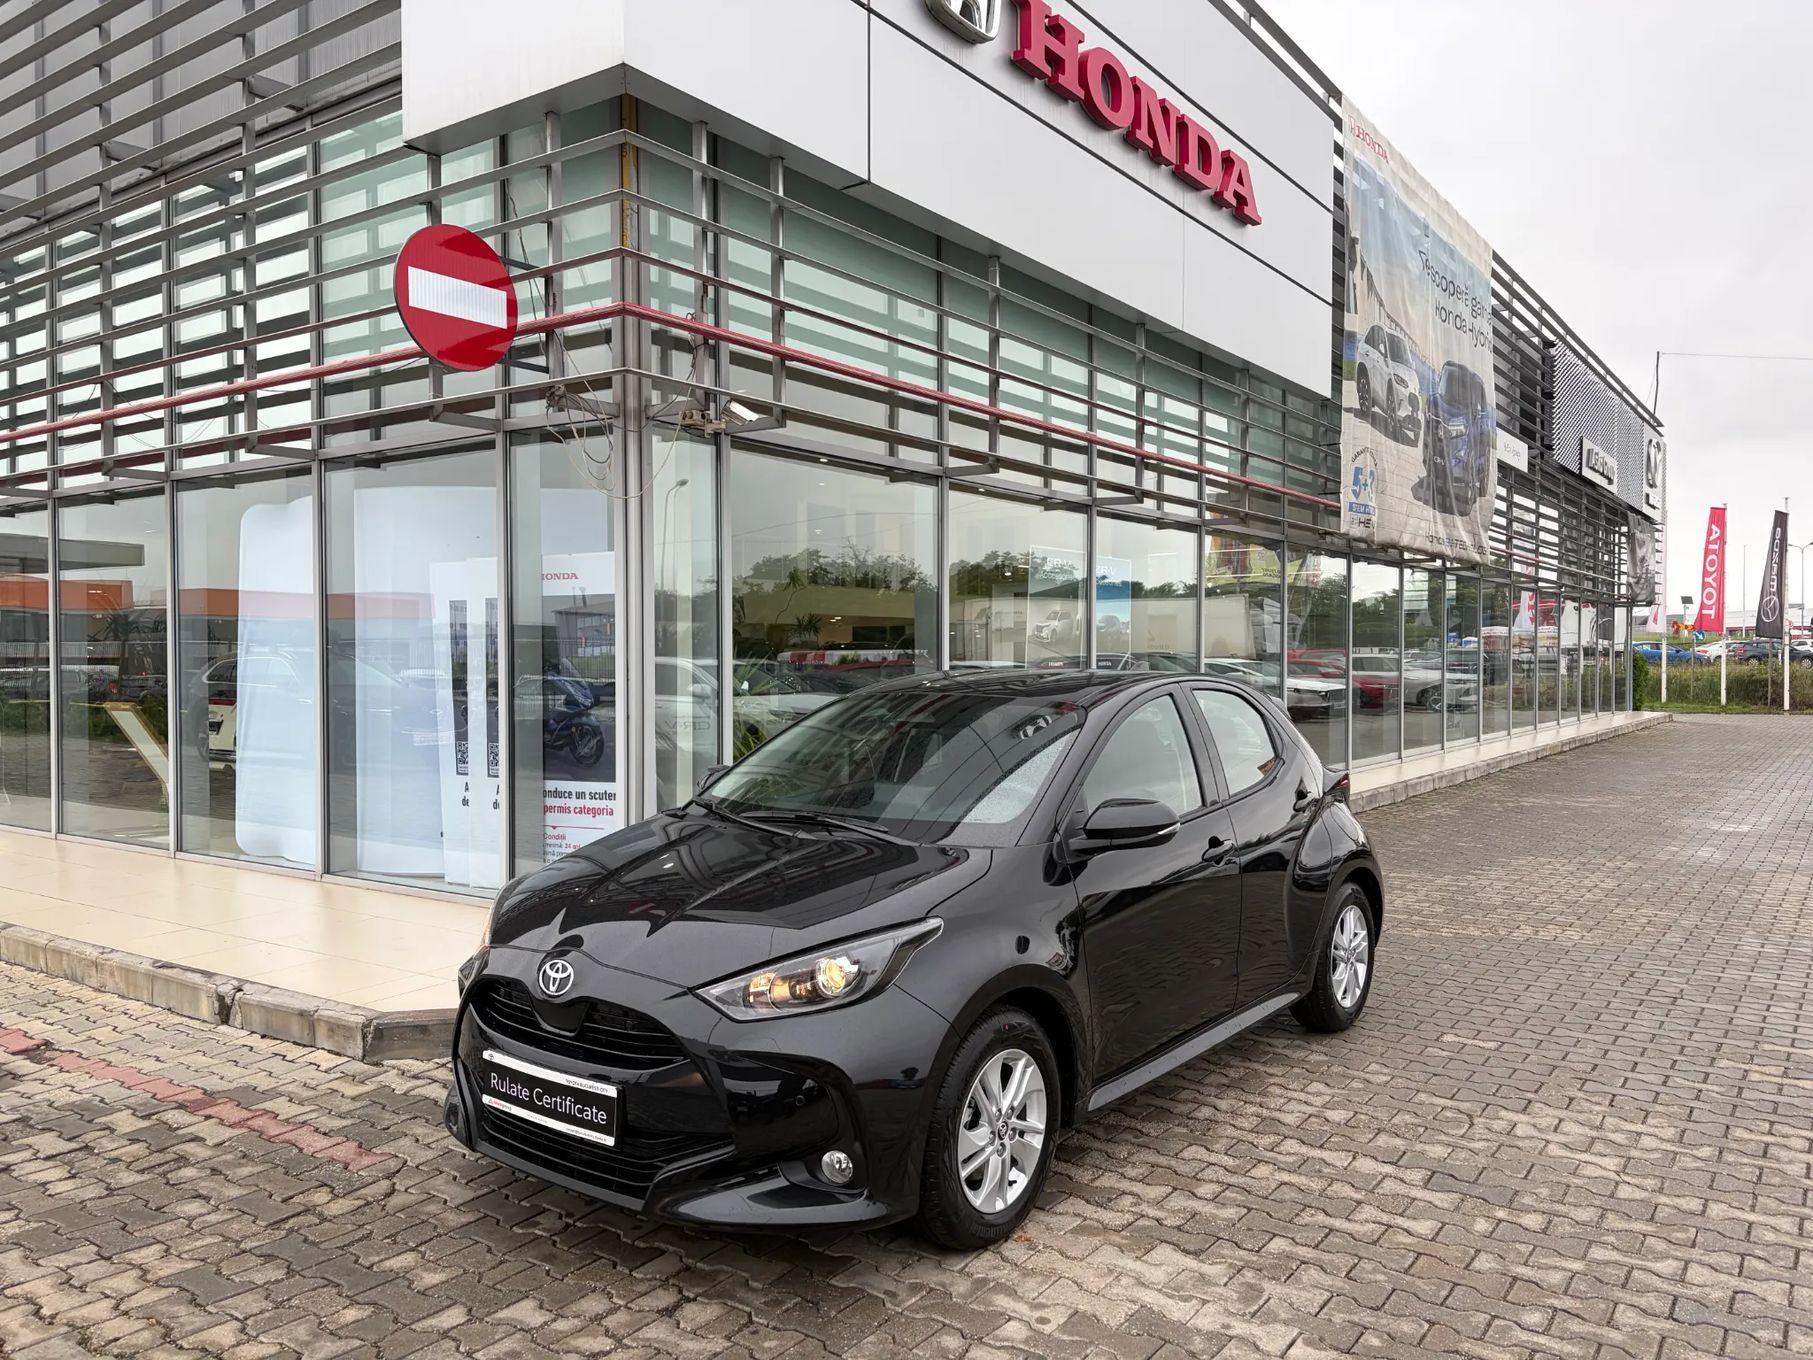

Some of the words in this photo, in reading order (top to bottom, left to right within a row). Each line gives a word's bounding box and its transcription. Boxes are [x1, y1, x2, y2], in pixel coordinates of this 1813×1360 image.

[1010, 0, 1262, 226] HONDA
[1354, 125, 1389, 165] HONDA
[543, 804, 571, 815] permis
[573, 805, 614, 818] categoria
[575, 790, 586, 800] un
[588, 791, 616, 801] scuter
[490, 1072, 530, 1101] Rulate
[533, 1087, 607, 1125] Certificate
